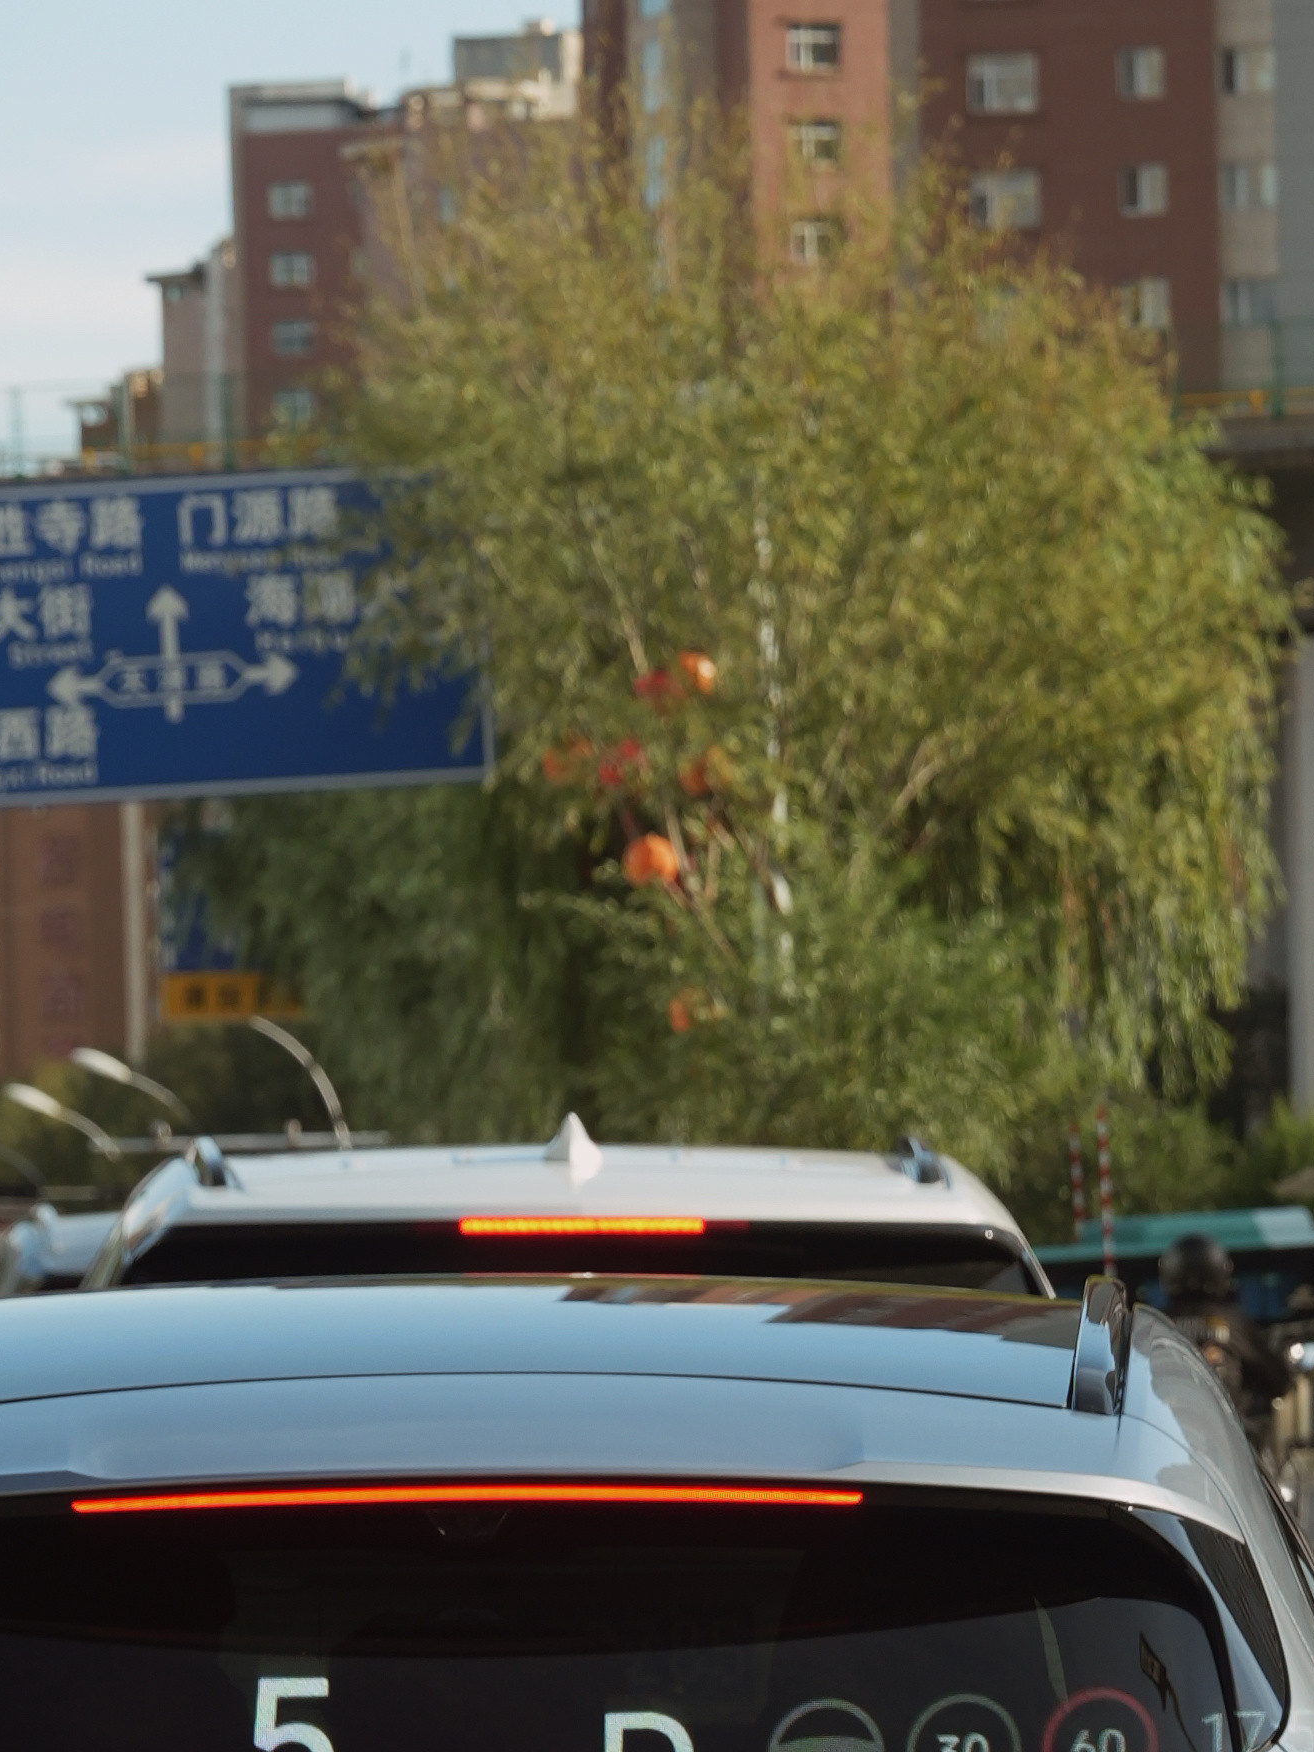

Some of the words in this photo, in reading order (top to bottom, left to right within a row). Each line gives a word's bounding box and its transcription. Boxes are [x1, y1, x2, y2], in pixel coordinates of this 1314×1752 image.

[177, 486, 339, 546] 门源路
[79, 551, 143, 577] Road
[35, 761, 98, 786] Road
